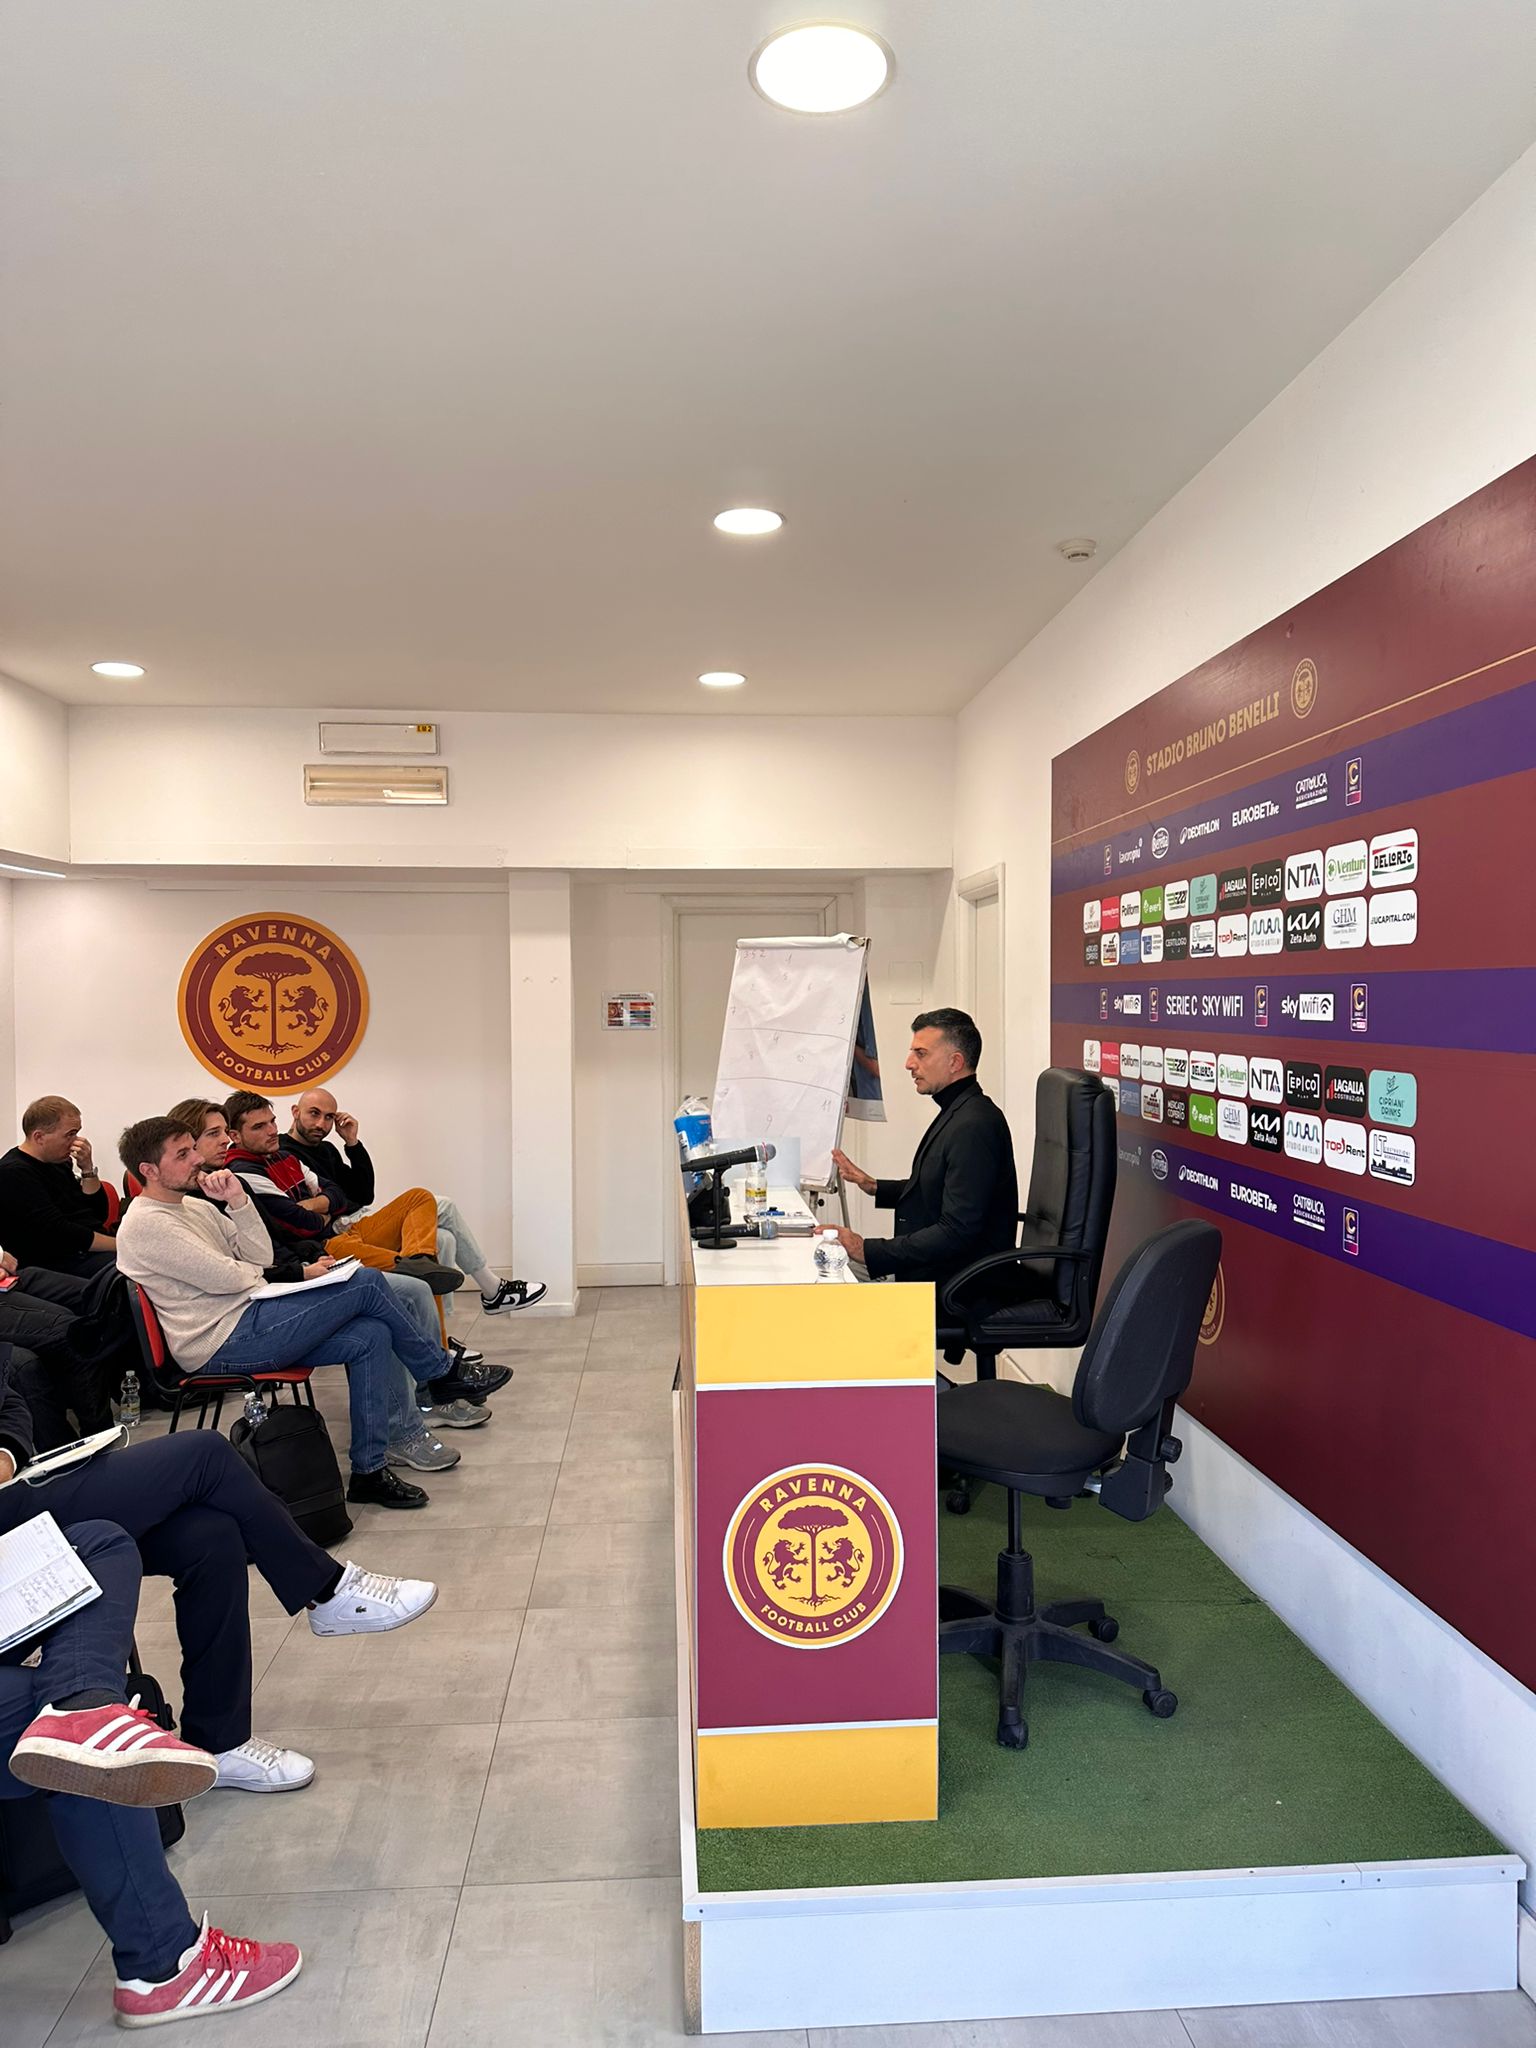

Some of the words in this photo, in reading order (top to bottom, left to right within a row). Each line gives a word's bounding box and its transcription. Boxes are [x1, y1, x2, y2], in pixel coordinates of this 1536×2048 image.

[1146, 739, 1184, 776] STADIO
[1186, 718, 1226, 758] BRUNO
[1229, 692, 1280, 738] BENELLI
[1296, 773, 1328, 794] CATTOLICA
[1188, 818, 1220, 840] DECATHLON
[1338, 855, 1366, 874] Venturi
[1288, 863, 1320, 890] NTA
[1333, 907, 1356, 924] GHM
[214, 924, 332, 961] RAVENNA
[1290, 934, 1302, 944] Zeta
[1303, 932, 1316, 942] Auto
[1166, 996, 1190, 1015] SERIE
[1192, 996, 1198, 1016] C
[1202, 996, 1220, 1016] SKY
[1222, 996, 1243, 1016] WIFI
[1282, 995, 1298, 1018] sky
[1302, 997, 1320, 1014] wifi
[216, 1050, 290, 1080] FOOTBALL
[295, 1051, 331, 1076] CLUB
[1226, 1065, 1246, 1082] Venturi
[1252, 1068, 1280, 1092] NTA
[1334, 1079, 1365, 1096] LAGALLA
[1382, 1106, 1401, 1118] DRINKS
[1254, 1130, 1264, 1142] Zeta
[1265, 1134, 1278, 1145] Auto
[1325, 1140, 1342, 1152] TOP
[1346, 1144, 1365, 1158] Rent
[1186, 1168, 1218, 1192] DECATHLON
[1294, 1194, 1325, 1216] CATTOLICA
[759, 1478, 867, 1512] RAVENNA
[760, 1604, 830, 1632] FOOTBALL
[833, 1602, 867, 1628] CLUB
